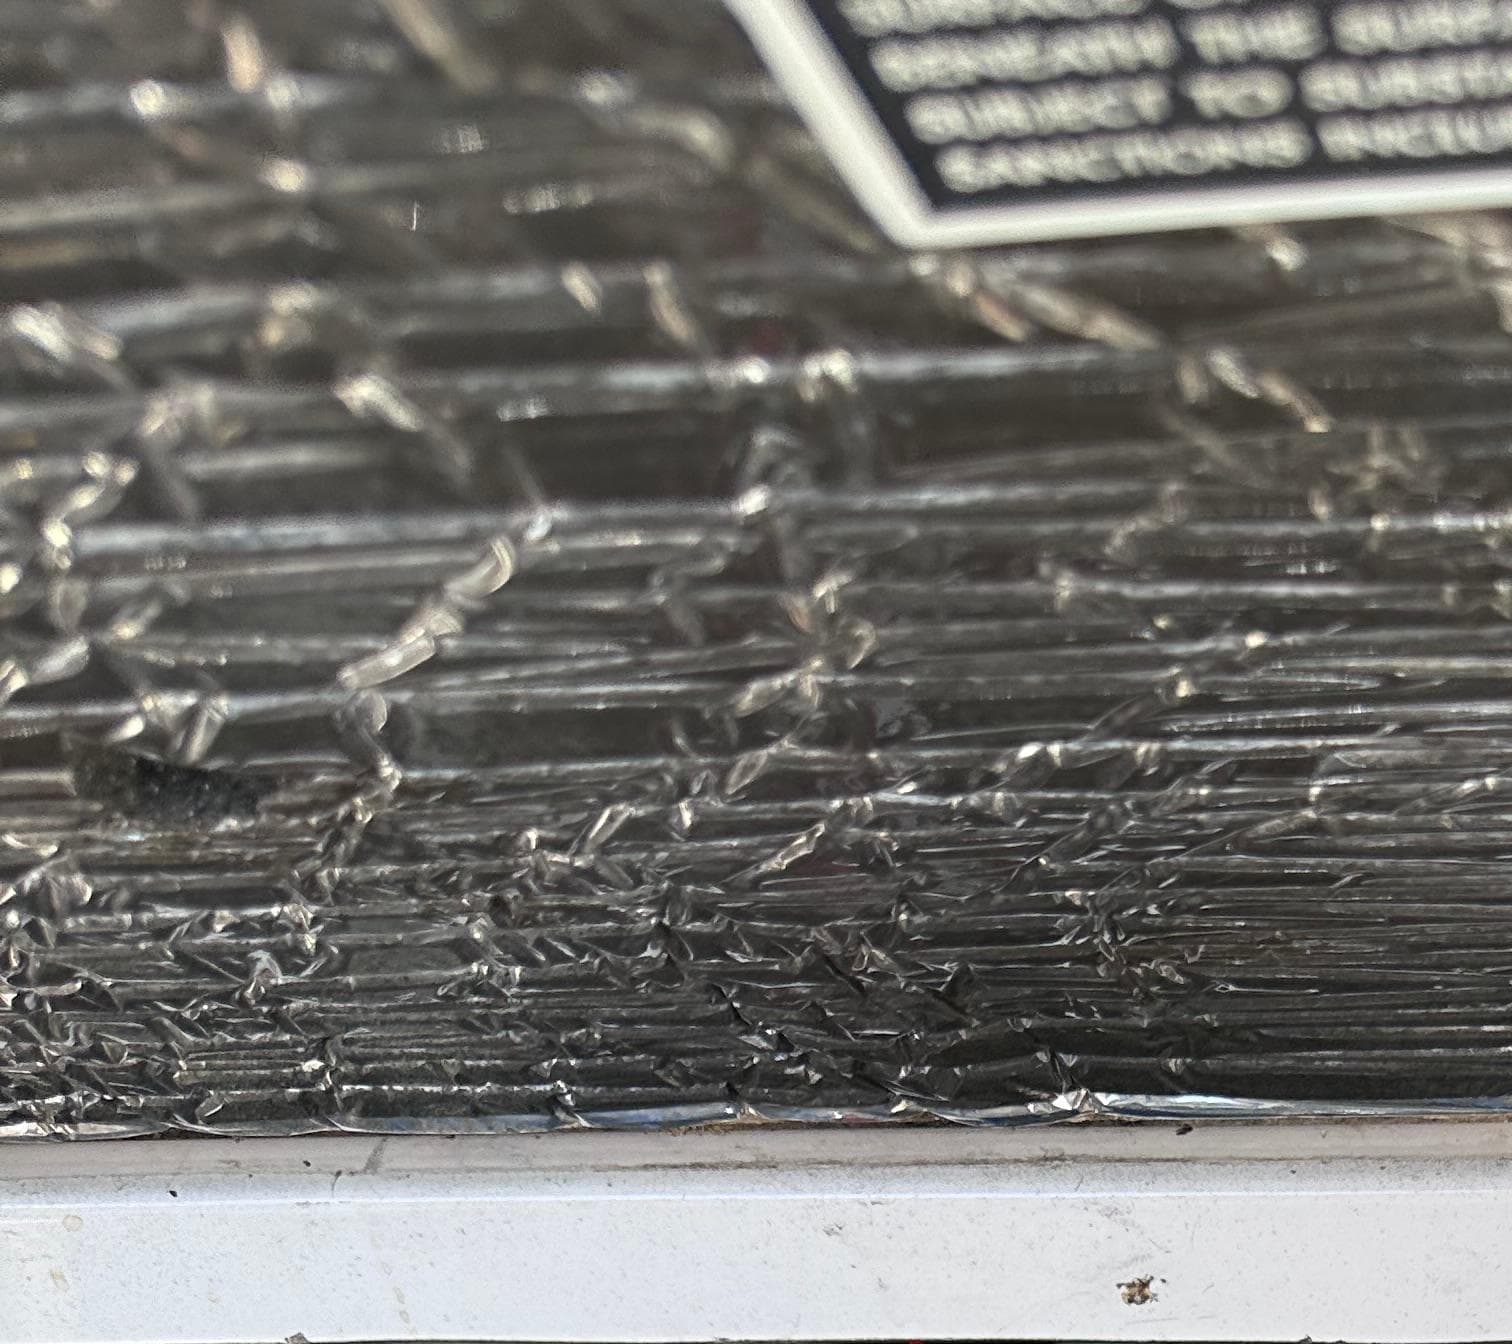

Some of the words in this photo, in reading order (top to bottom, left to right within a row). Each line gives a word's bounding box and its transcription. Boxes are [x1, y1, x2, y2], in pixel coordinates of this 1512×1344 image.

[903, 74, 1172, 144] SUBJECT
[1181, 68, 1294, 120] TO
[935, 117, 1311, 192] SANCTIONS
